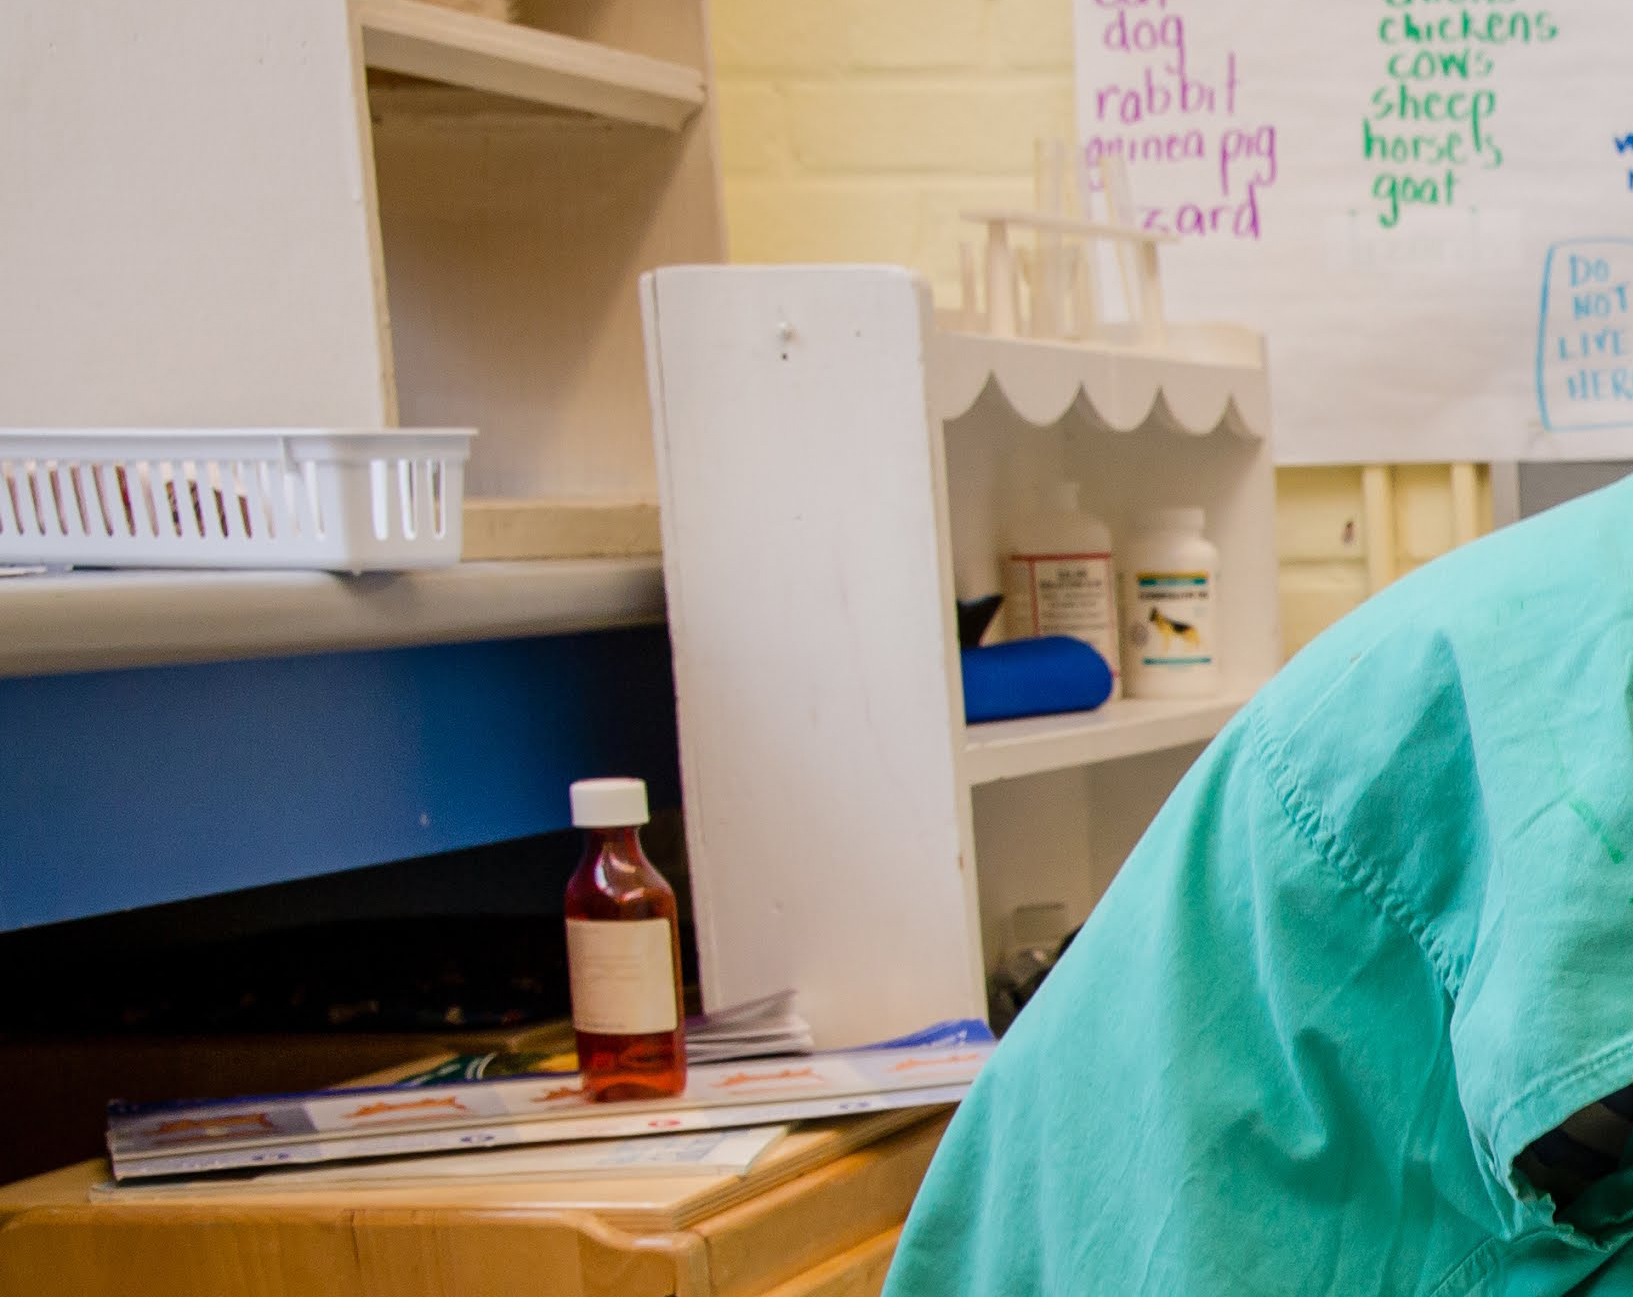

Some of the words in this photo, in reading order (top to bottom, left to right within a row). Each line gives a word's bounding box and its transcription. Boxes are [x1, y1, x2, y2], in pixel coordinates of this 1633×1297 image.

[1103, 10, 1186, 75] dog
[1379, 10, 1560, 44] chickens
[1095, 50, 1241, 125] rabbit
[1387, 47, 1495, 81] cows
[1371, 82, 1498, 154] sheep
[1219, 126, 1278, 196] pig
[1138, 182, 1262, 240] zard
[1371, 169, 1460, 228] goat
[1568, 253, 1611, 287] DO
[1572, 281, 1631, 320] NOT
[1557, 327, 1628, 361] LIVE
